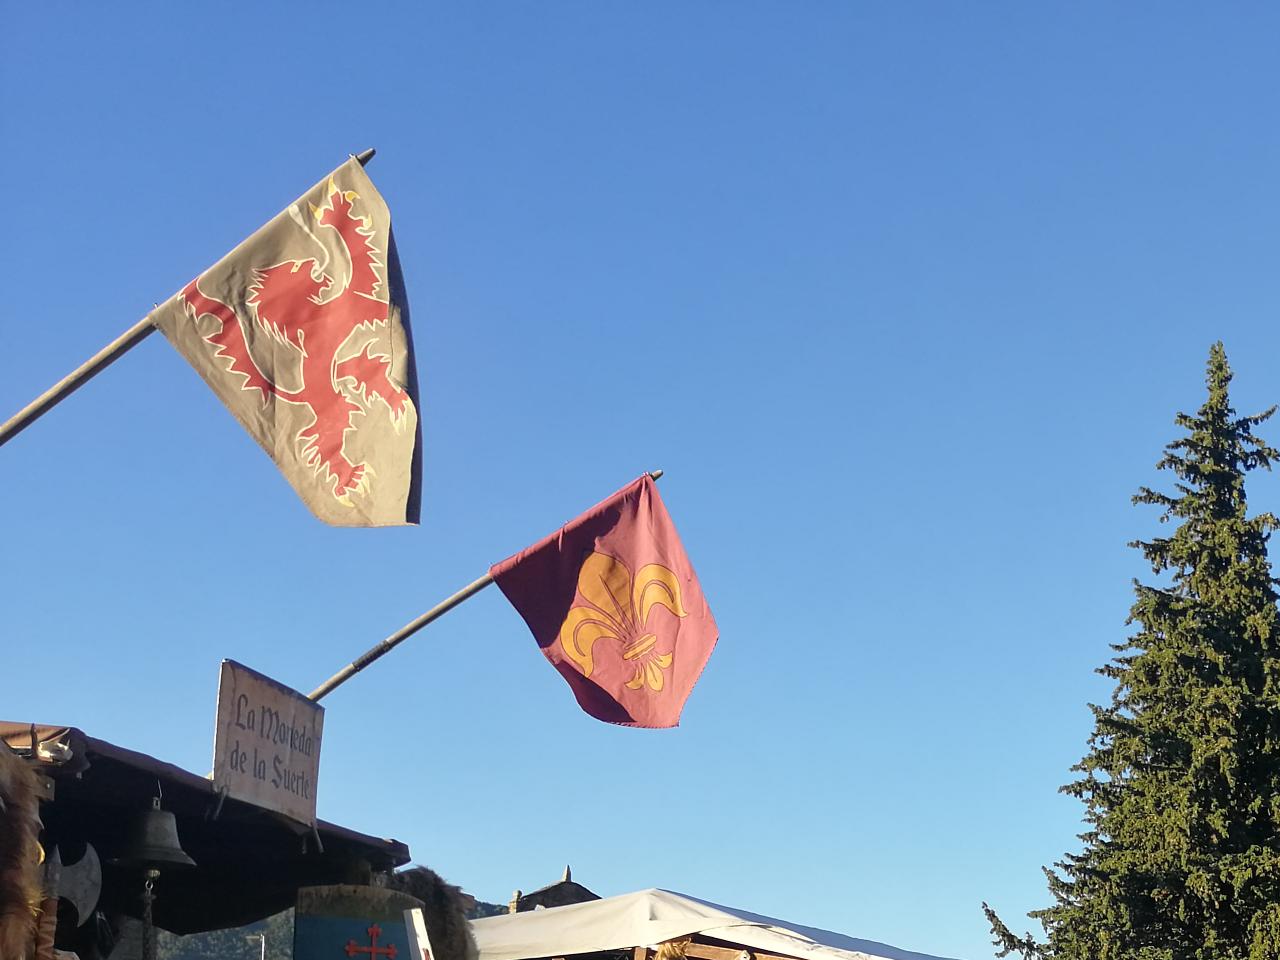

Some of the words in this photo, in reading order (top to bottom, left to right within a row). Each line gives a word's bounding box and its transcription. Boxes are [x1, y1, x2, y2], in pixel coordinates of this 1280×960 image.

[235, 693, 256, 732] La
[260, 705, 312, 757] Moneda
[229, 739, 248, 774] de
[253, 748, 266, 781] la
[271, 757, 310, 800] Suerte
